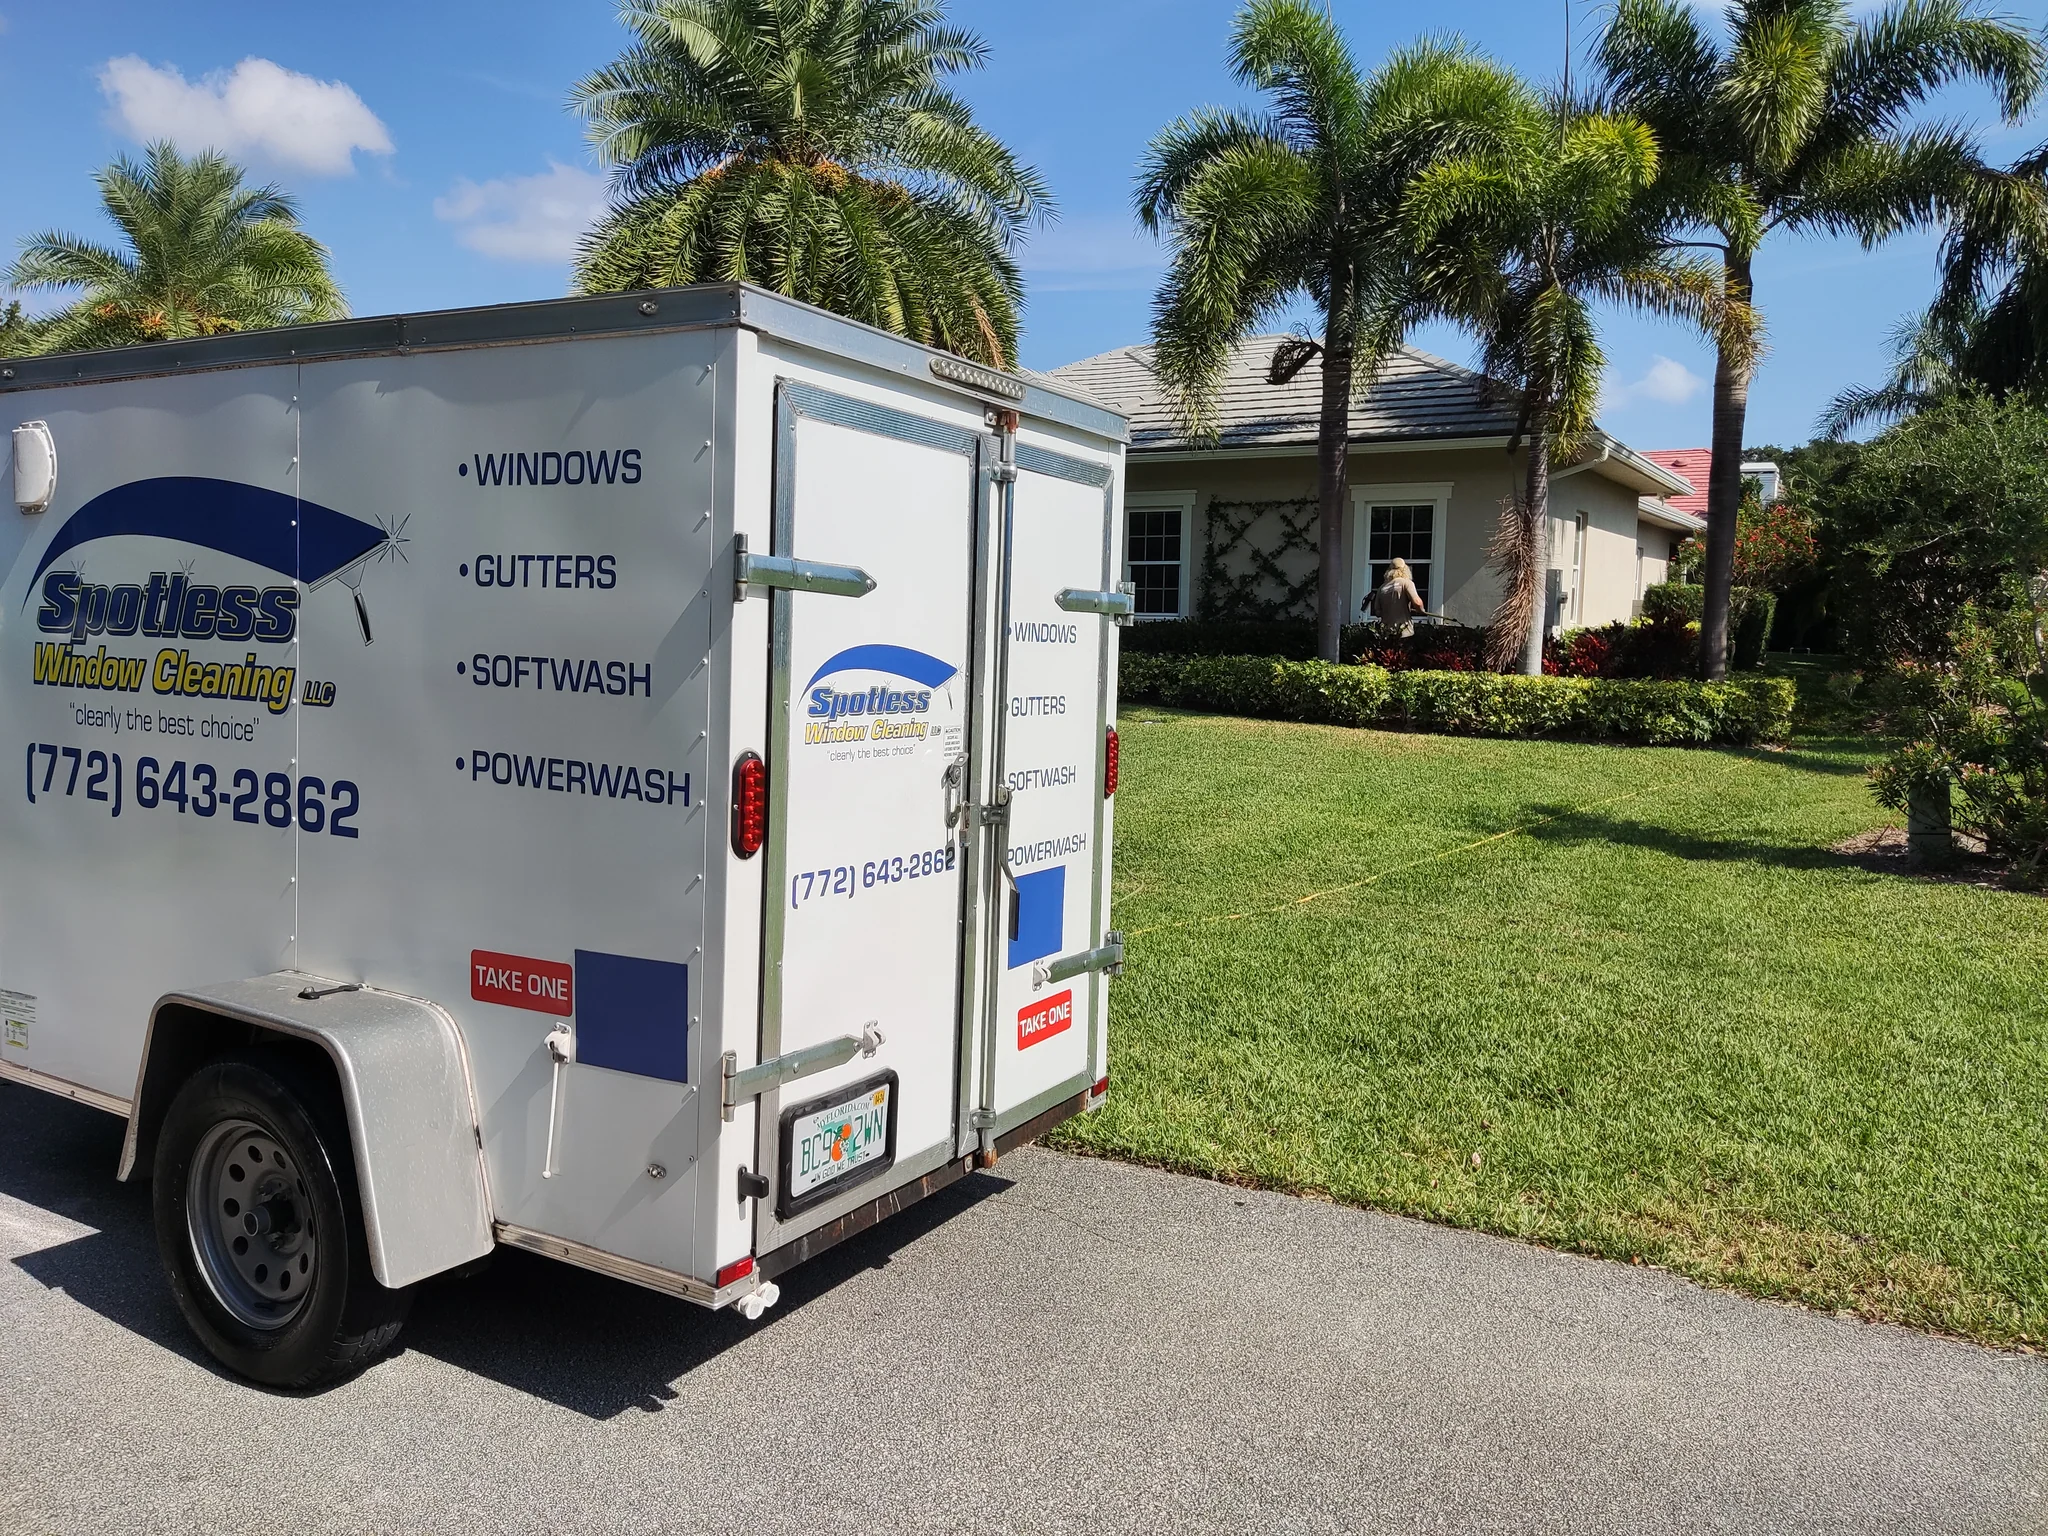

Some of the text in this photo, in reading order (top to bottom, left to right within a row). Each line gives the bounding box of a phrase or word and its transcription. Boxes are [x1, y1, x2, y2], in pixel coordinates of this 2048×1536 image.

[474, 449, 642, 486] WINDOWS
[475, 554, 617, 589] GUTTERS
[37, 570, 301, 644] Spotless
[1014, 621, 1077, 644] WINDOWS
[33, 641, 336, 715] Window Cleaning LLC
[472, 654, 651, 698] SOFTWASH
[807, 685, 932, 721] Spotless
[1011, 695, 1066, 717] GUTTERS
[69, 702, 260, 742] “clearly the best choice”
[805, 721, 869, 745] Window
[871, 718, 929, 741] Cleaning
[857, 747, 871, 759] the
[872, 746, 890, 758] best
[26, 742, 360, 839] (772) 643-2862
[472, 750, 691, 807] POWERWASH
[1008, 765, 1077, 791] SOFTWASH
[1008, 832, 1087, 866] POWERWASH
[792, 846, 956, 909] (772) 643-2862
[475, 965, 568, 1001] TAKE ONE
[1020, 1001, 1070, 1038] TAKE ONE
[800, 1105, 884, 1177] BC9 2WN
[822, 1166, 835, 1179] GOD
[836, 1161, 845, 1173] WE
[847, 1150, 867, 1169] TRUST
